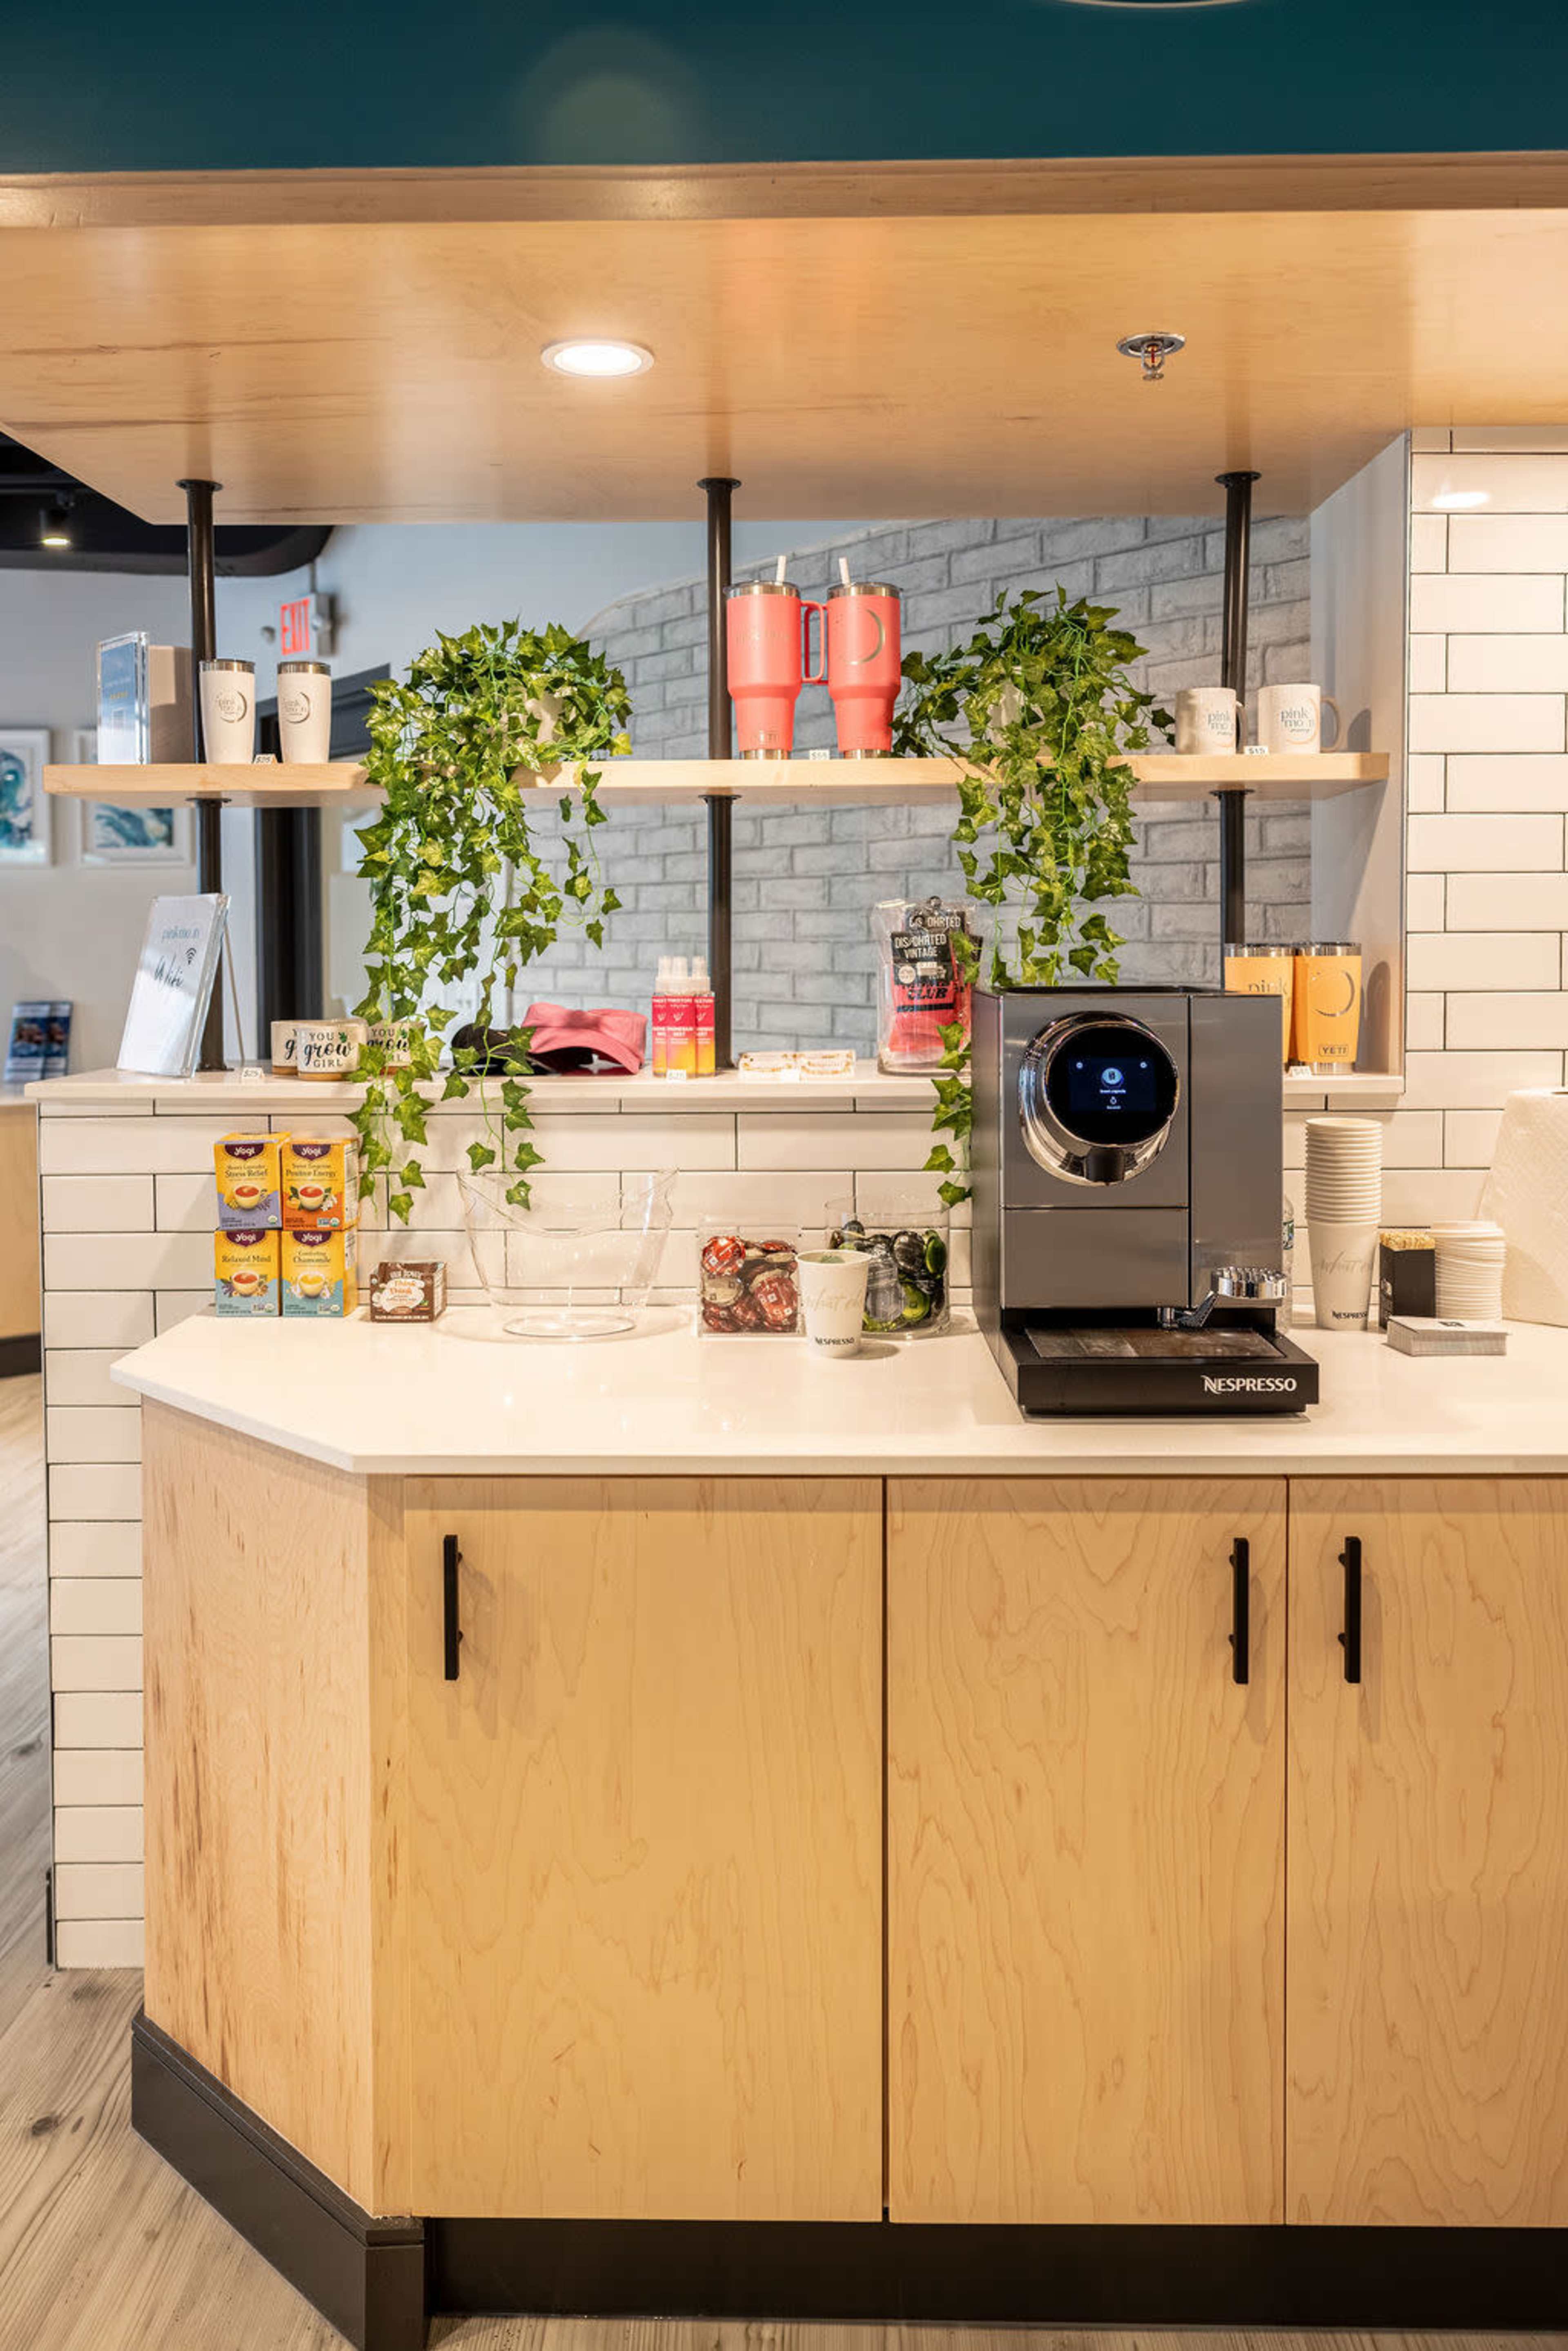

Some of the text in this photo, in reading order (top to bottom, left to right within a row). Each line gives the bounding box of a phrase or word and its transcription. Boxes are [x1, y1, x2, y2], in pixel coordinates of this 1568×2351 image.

[281, 598, 310, 656] EXIT
[1281, 707, 1308, 722] pink
[309, 1033, 334, 1041] YOU
[372, 1028, 395, 1037] YOU
[303, 1042, 354, 1067] grow
[1323, 1046, 1348, 1055] YETI
[313, 1060, 344, 1068] GIRL
[1332, 1310, 1368, 1320] NESPRESS
[815, 1337, 855, 1345] NESPRESSO
[1200, 1374, 1297, 1394] NESPRESSO
